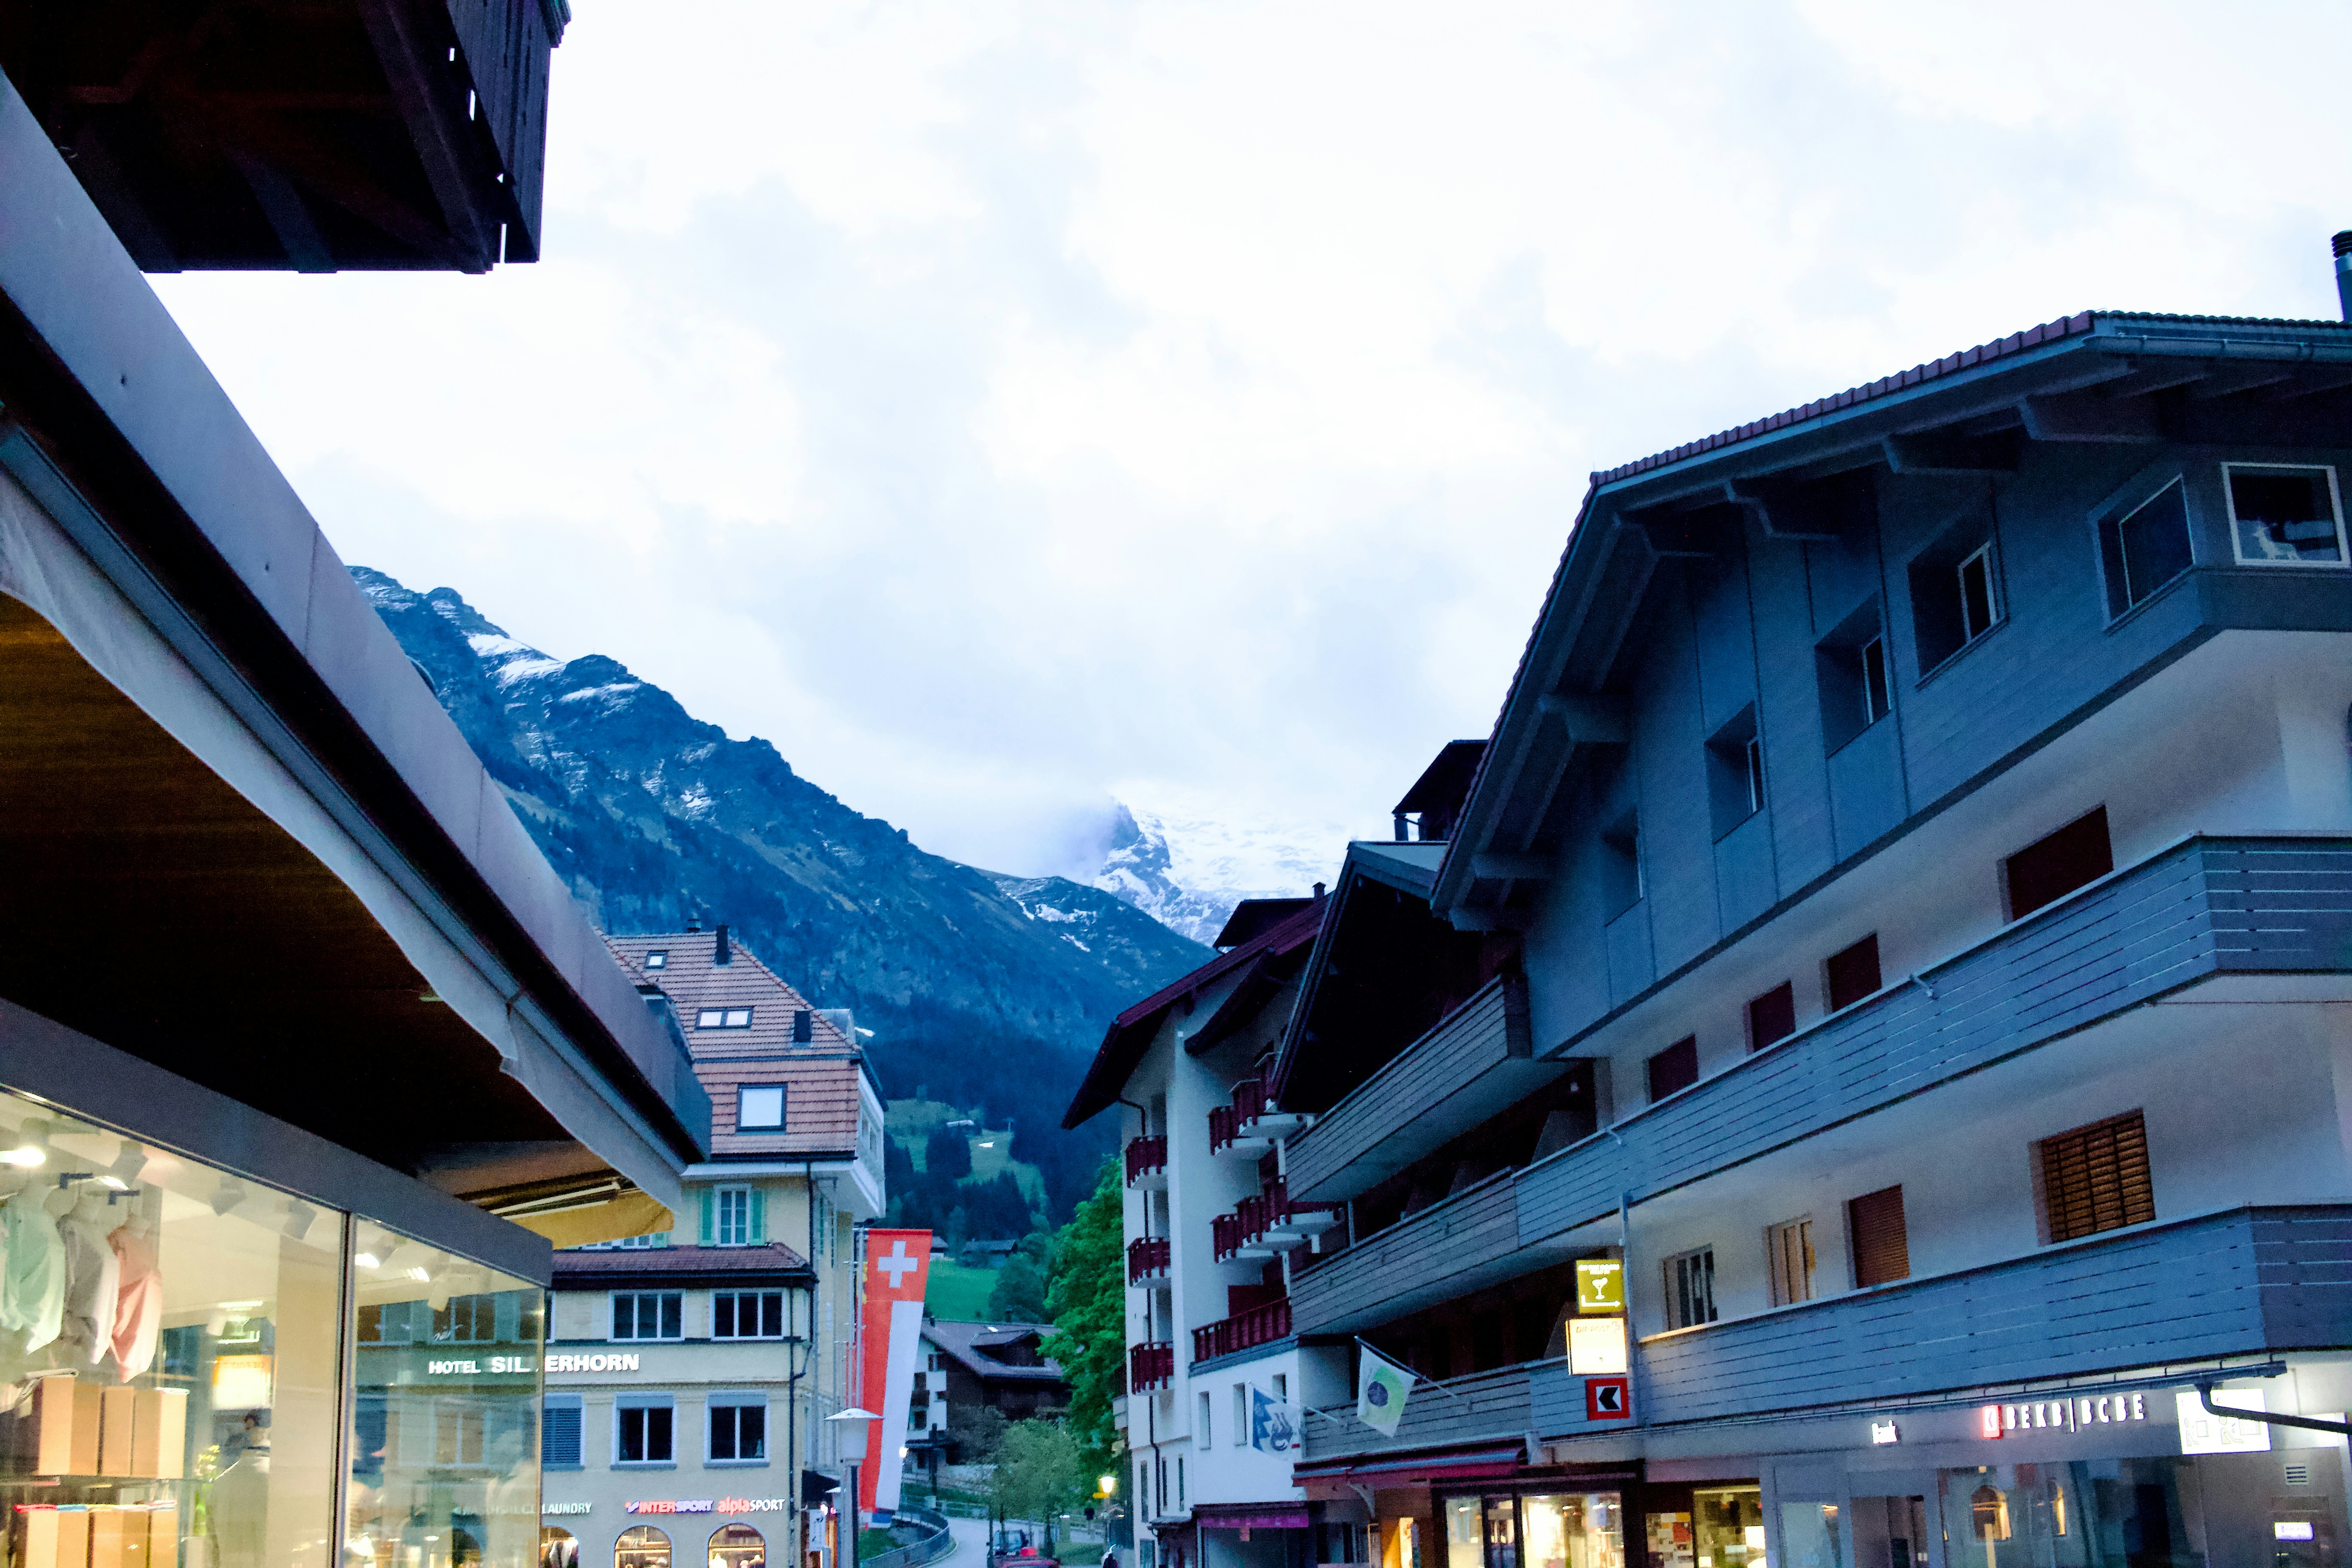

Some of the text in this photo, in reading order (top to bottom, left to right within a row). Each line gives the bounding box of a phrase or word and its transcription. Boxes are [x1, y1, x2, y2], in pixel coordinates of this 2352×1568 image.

[429, 1354, 640, 1374] HOTEL SILERHORN
[542, 1503, 592, 1514] LAUNDRY
[639, 1499, 714, 1513] INTERSPORT
